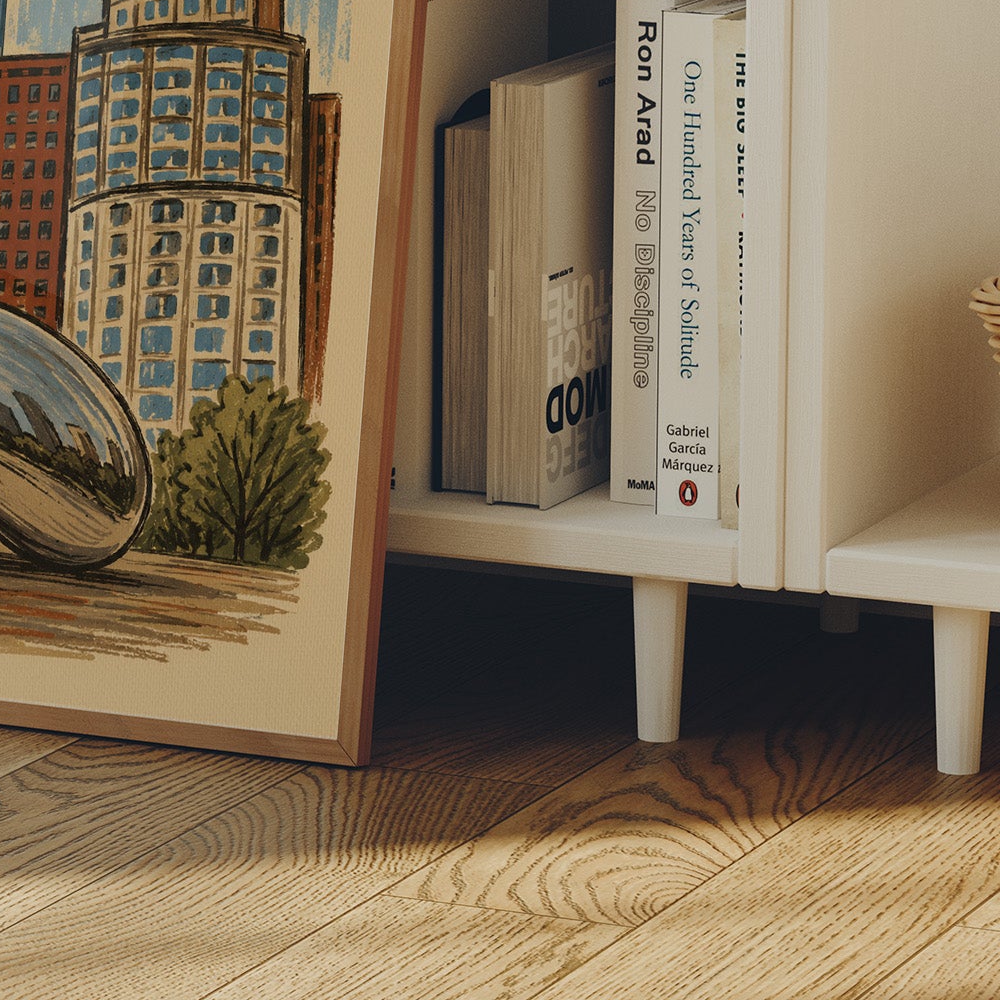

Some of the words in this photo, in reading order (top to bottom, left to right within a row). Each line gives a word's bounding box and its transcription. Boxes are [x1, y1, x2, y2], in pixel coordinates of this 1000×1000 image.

[637, 21, 658, 81] Ron
[683, 60, 702, 104] One
[636, 92, 656, 165] Arad
[682, 112, 701, 201] Hundred
[635, 190, 656, 232] No
[681, 207, 701, 261] Years
[681, 268, 700, 292] of
[630, 243, 655, 389] Discipline
[680, 298, 700, 380] Solitude
[546, 365, 607, 434] MOD
[666, 424, 709, 438] Gabriel
[668, 442, 706, 455] García
[627, 479, 655, 490] MoMA
[662, 458, 713, 473] Márquez
